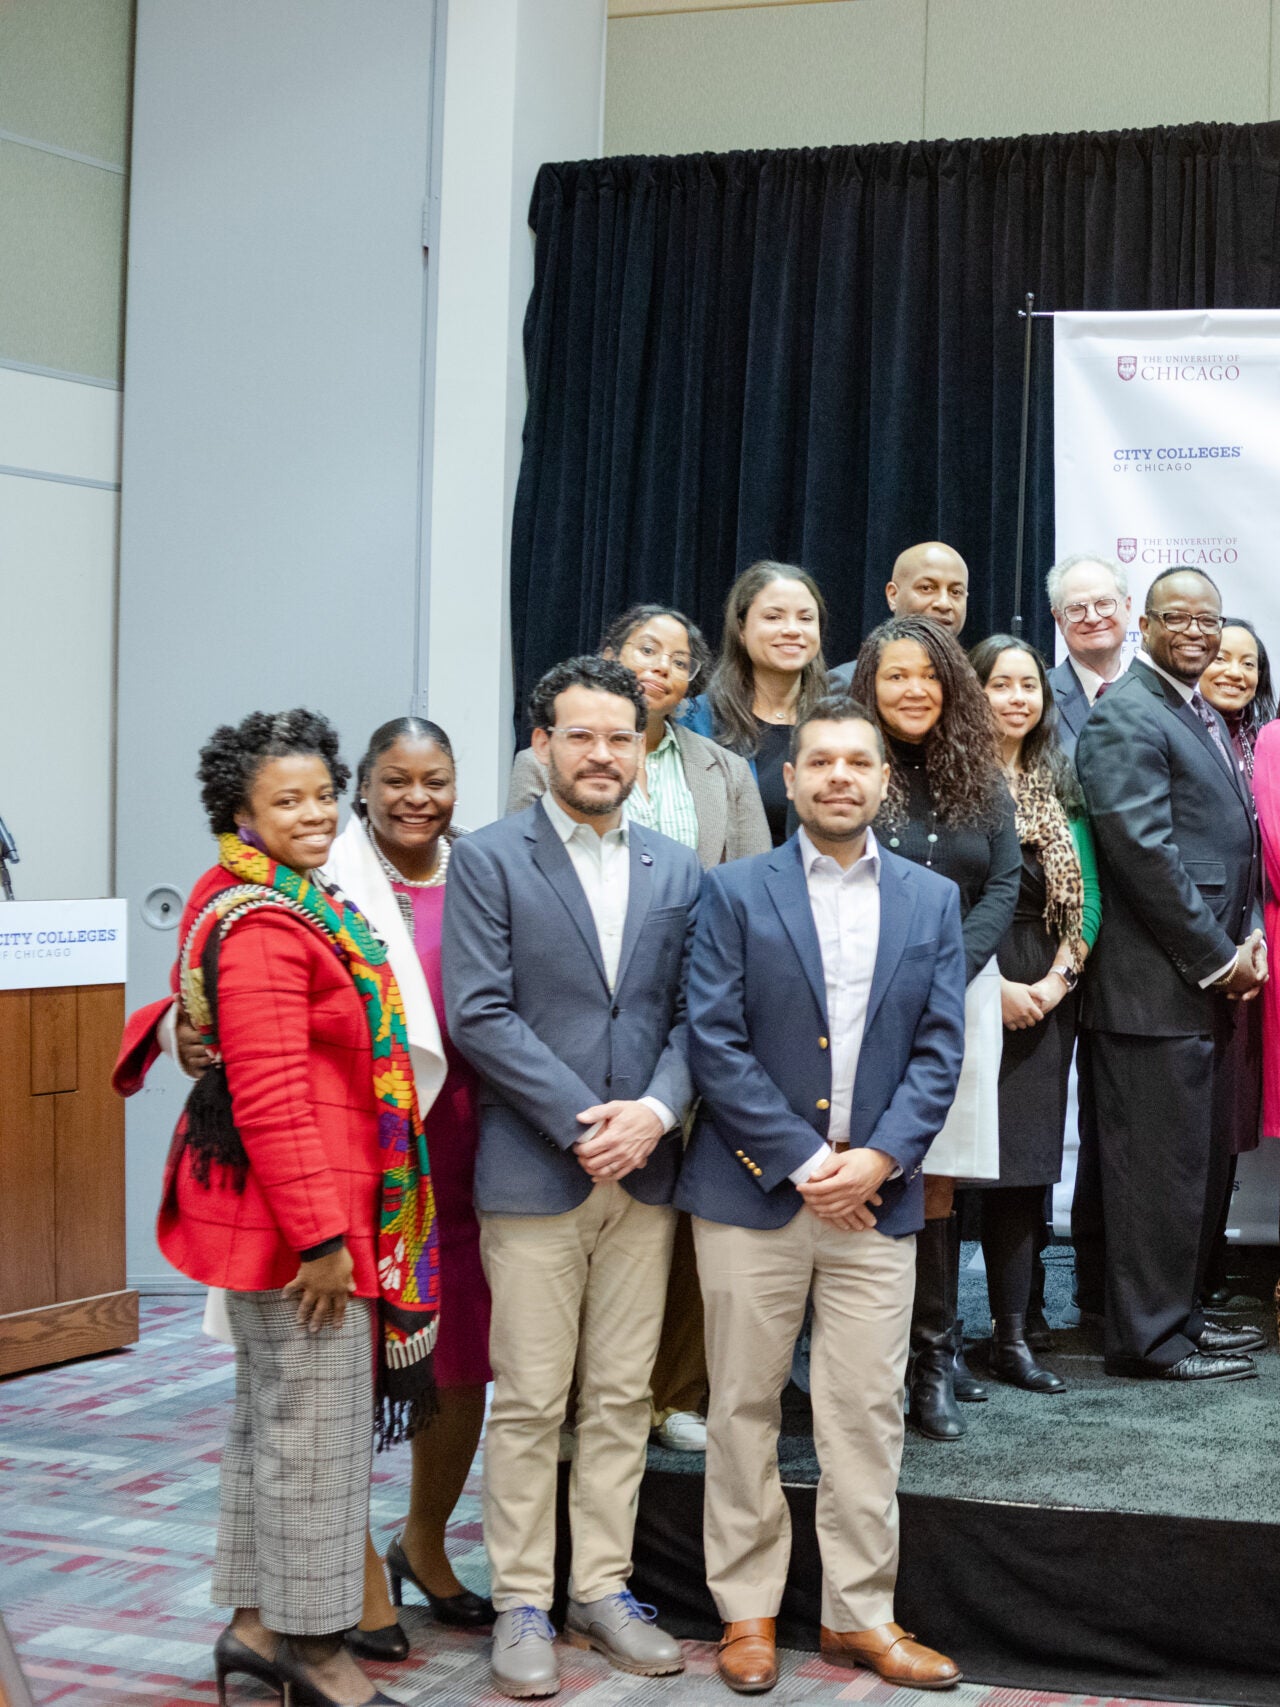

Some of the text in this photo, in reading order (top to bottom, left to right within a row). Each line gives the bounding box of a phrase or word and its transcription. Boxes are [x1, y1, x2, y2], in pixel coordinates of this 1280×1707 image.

[1143, 354, 1240, 363] THE UNIVERSITY OF
[1141, 365, 1240, 381] CHICAGO
[1114, 446, 1241, 461] CITY COLLEGES
[1113, 462, 1192, 472] OF CHICAGO
[1143, 537, 1238, 546] THE UNIVERSITY OF
[1141, 548, 1238, 564] CHICAGO
[37, 929, 117, 944] COLLEGES
[14, 948, 71, 960] CHICAGO
